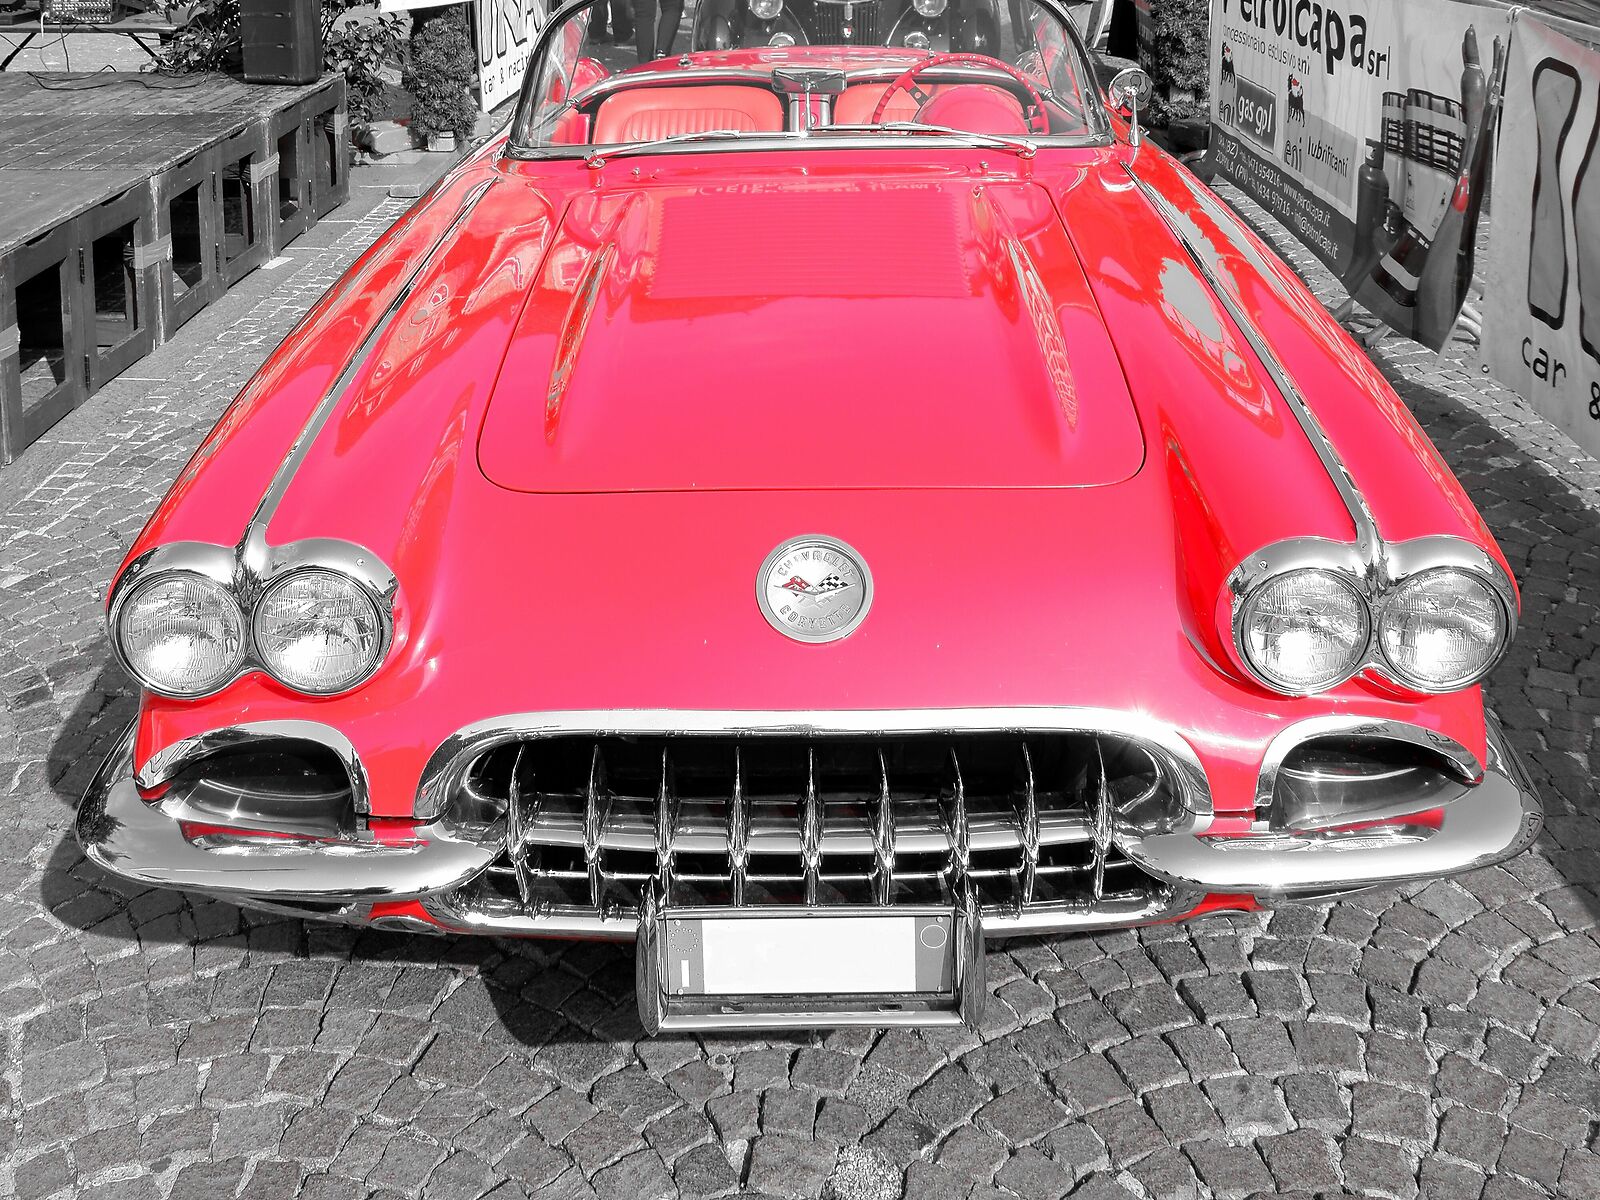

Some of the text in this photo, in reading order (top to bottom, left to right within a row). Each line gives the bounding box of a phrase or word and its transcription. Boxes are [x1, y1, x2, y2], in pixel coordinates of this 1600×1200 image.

[1366, 45, 1391, 81] srl
[1238, 95, 1273, 137] gas gpl
[1283, 136, 1302, 173] eni
[1307, 135, 1349, 178] lubrificanti
[1521, 336, 1567, 388] car
